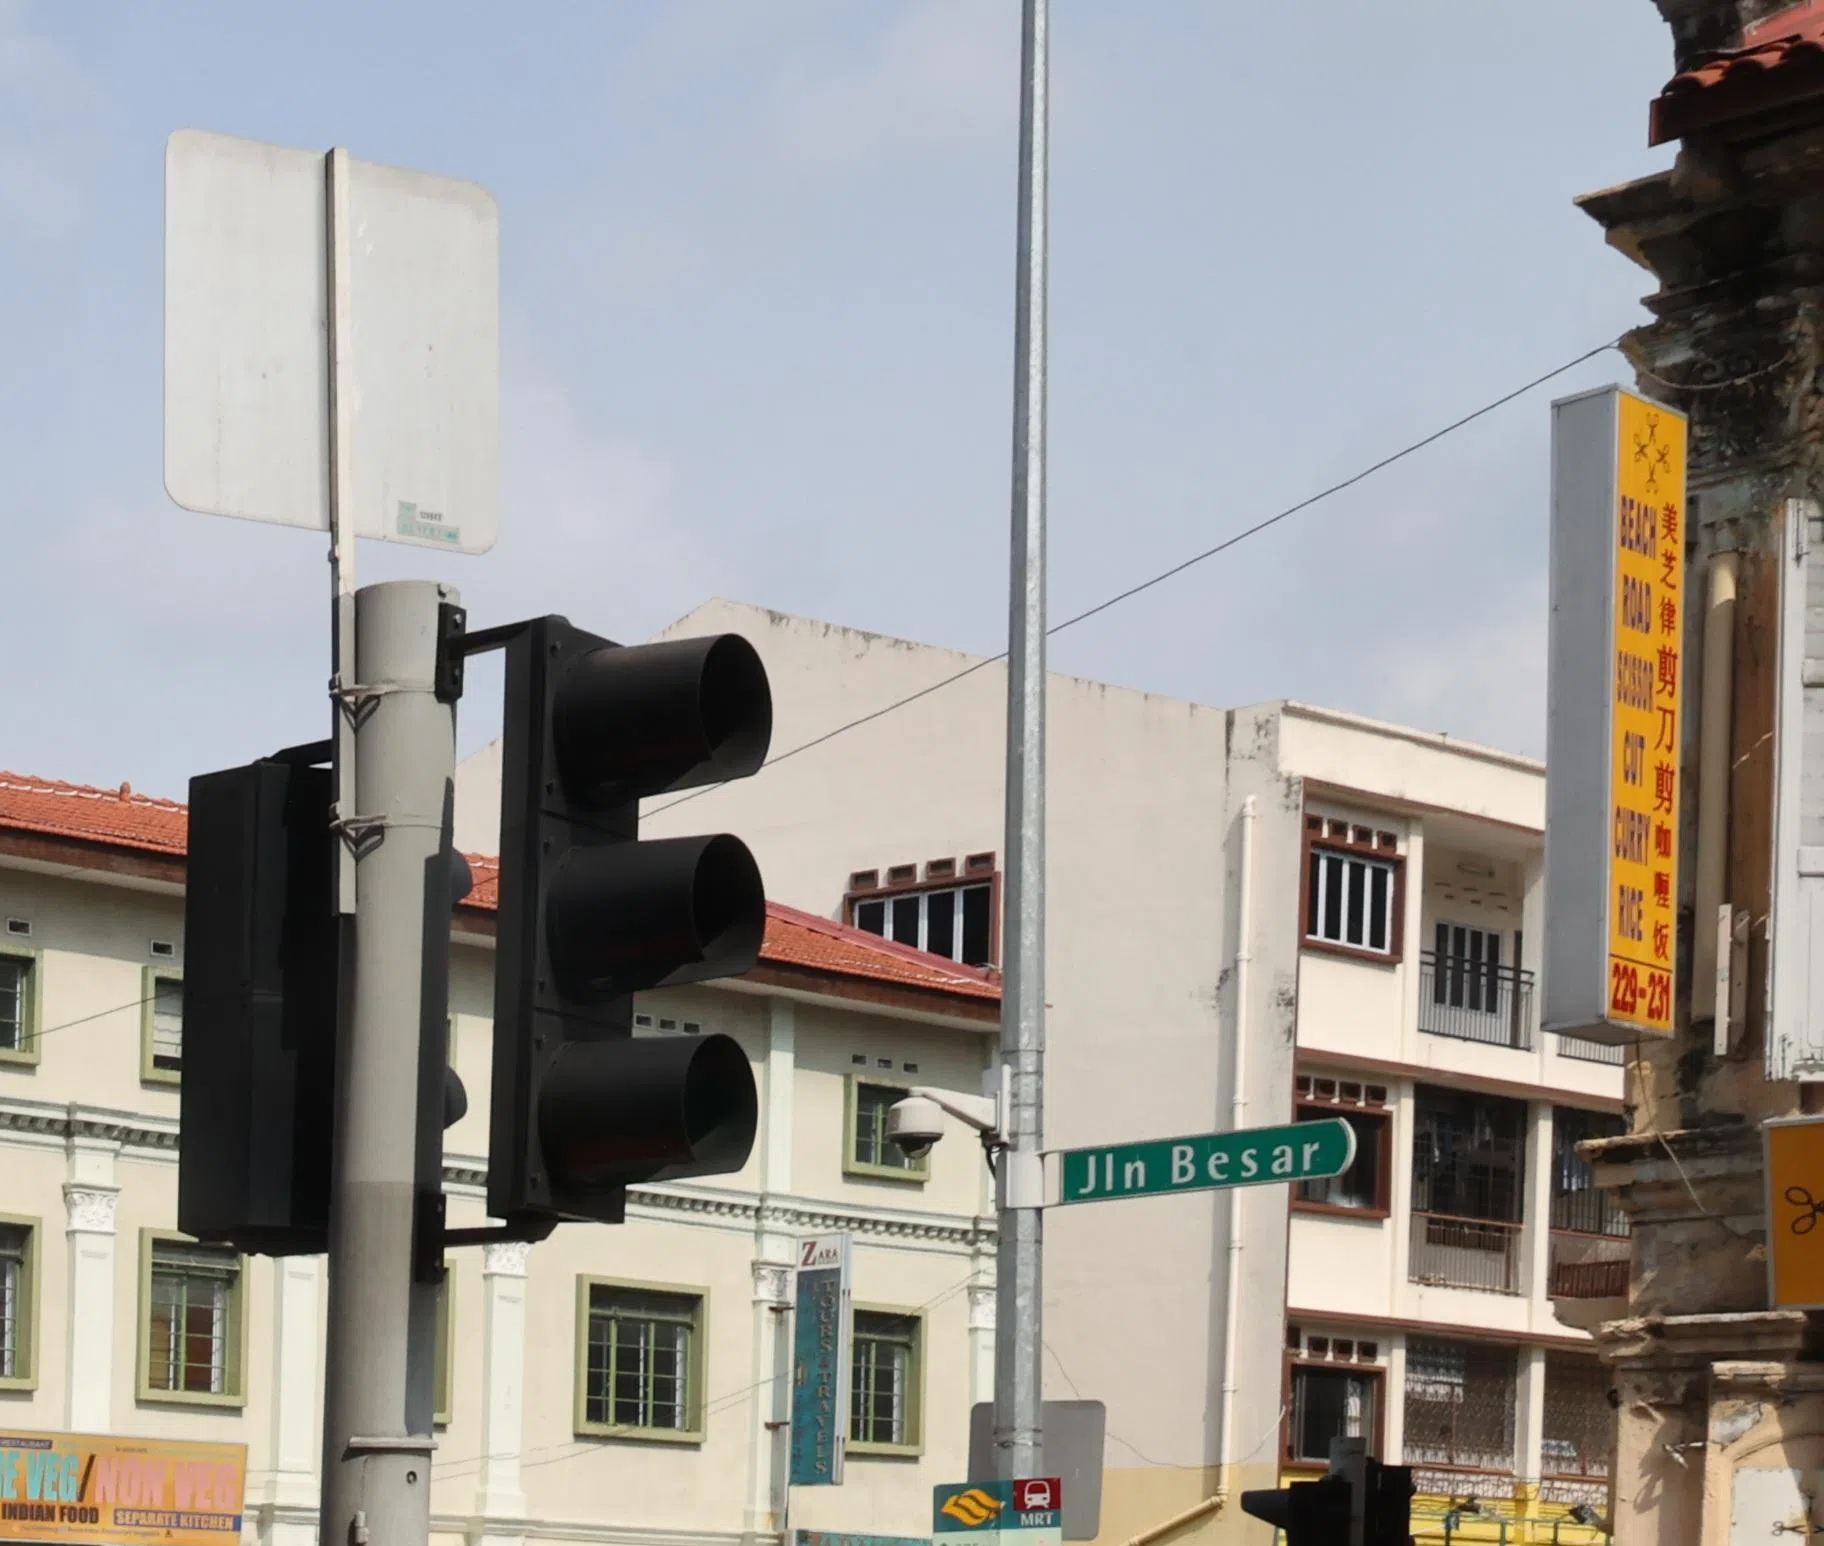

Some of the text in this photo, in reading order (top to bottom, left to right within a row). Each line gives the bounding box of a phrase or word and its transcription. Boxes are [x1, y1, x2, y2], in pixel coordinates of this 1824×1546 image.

[1621, 495, 1657, 560] BEACH
[1622, 574, 1651, 634] ROAD
[1617, 650, 1653, 714] SCISSOR
[1623, 730, 1645, 787] CUT
[1615, 805, 1650, 866] CURRY
[1618, 884, 1644, 942] RICE
[1612, 962, 1671, 1020] 229-231
[1079, 1141, 1320, 1194] Jln Besar
[801, 1241, 838, 1267] ZARA
[2, 1502, 56, 1521] INDIAN
[59, 1505, 99, 1524] FOOD
[173, 1461, 239, 1510] VEG
[116, 1510, 177, 1527] SEPARATE
[180, 1513, 234, 1530] KITCHEN
[1020, 1512, 1054, 1527] MRT
